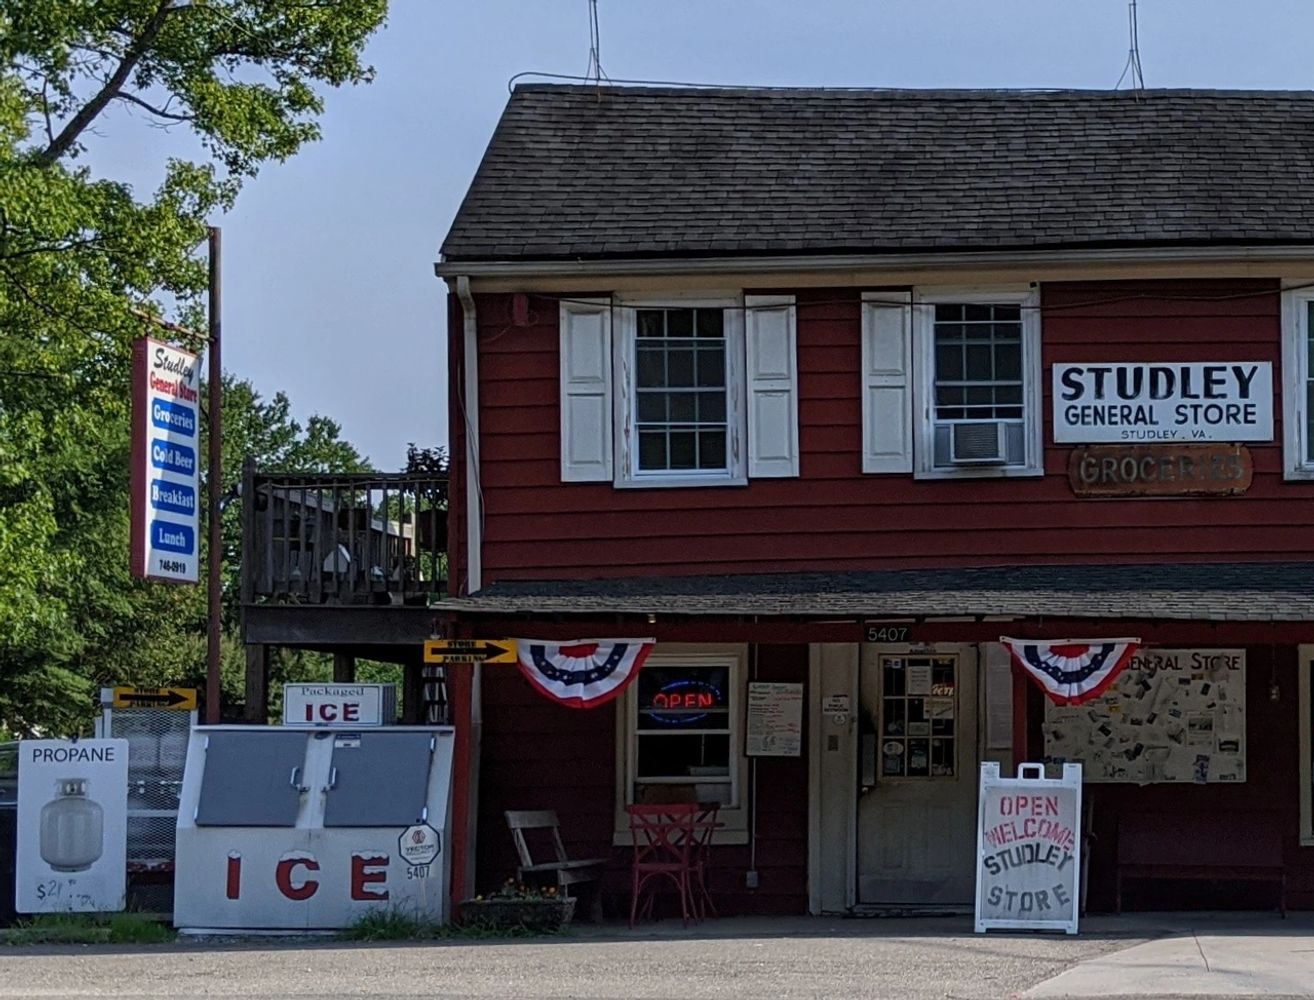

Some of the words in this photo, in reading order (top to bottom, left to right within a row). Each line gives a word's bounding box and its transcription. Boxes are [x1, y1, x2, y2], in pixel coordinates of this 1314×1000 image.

[153, 347, 194, 385] Studley
[150, 371, 178, 396] General
[179, 380, 198, 403] Store
[1061, 366, 1258, 400] STUDLEY
[153, 404, 194, 430] Groceries
[1064, 404, 1159, 425] GENERAL
[1174, 403, 1257, 425] STORE
[153, 445, 173, 464] Cold
[174, 449, 193, 469] Beer
[1080, 454, 1244, 484] GROCERIES
[152, 485, 194, 509] Breakfast
[158, 527, 186, 548] Lunch
[868, 628, 908, 641] 5407
[1125, 655, 1183, 671] ENERAL
[301, 687, 365, 697] Packaged
[653, 693, 712, 708] OPEN
[305, 703, 360, 721] ICE
[32, 747, 115, 762] PROPANE
[1000, 795, 1059, 816] OPEN
[985, 818, 1075, 852] WELCOME
[984, 843, 1075, 875] STUDLEY
[226, 850, 390, 901] ICE
[407, 866, 430, 880] 5407
[988, 883, 1071, 912] STORE
